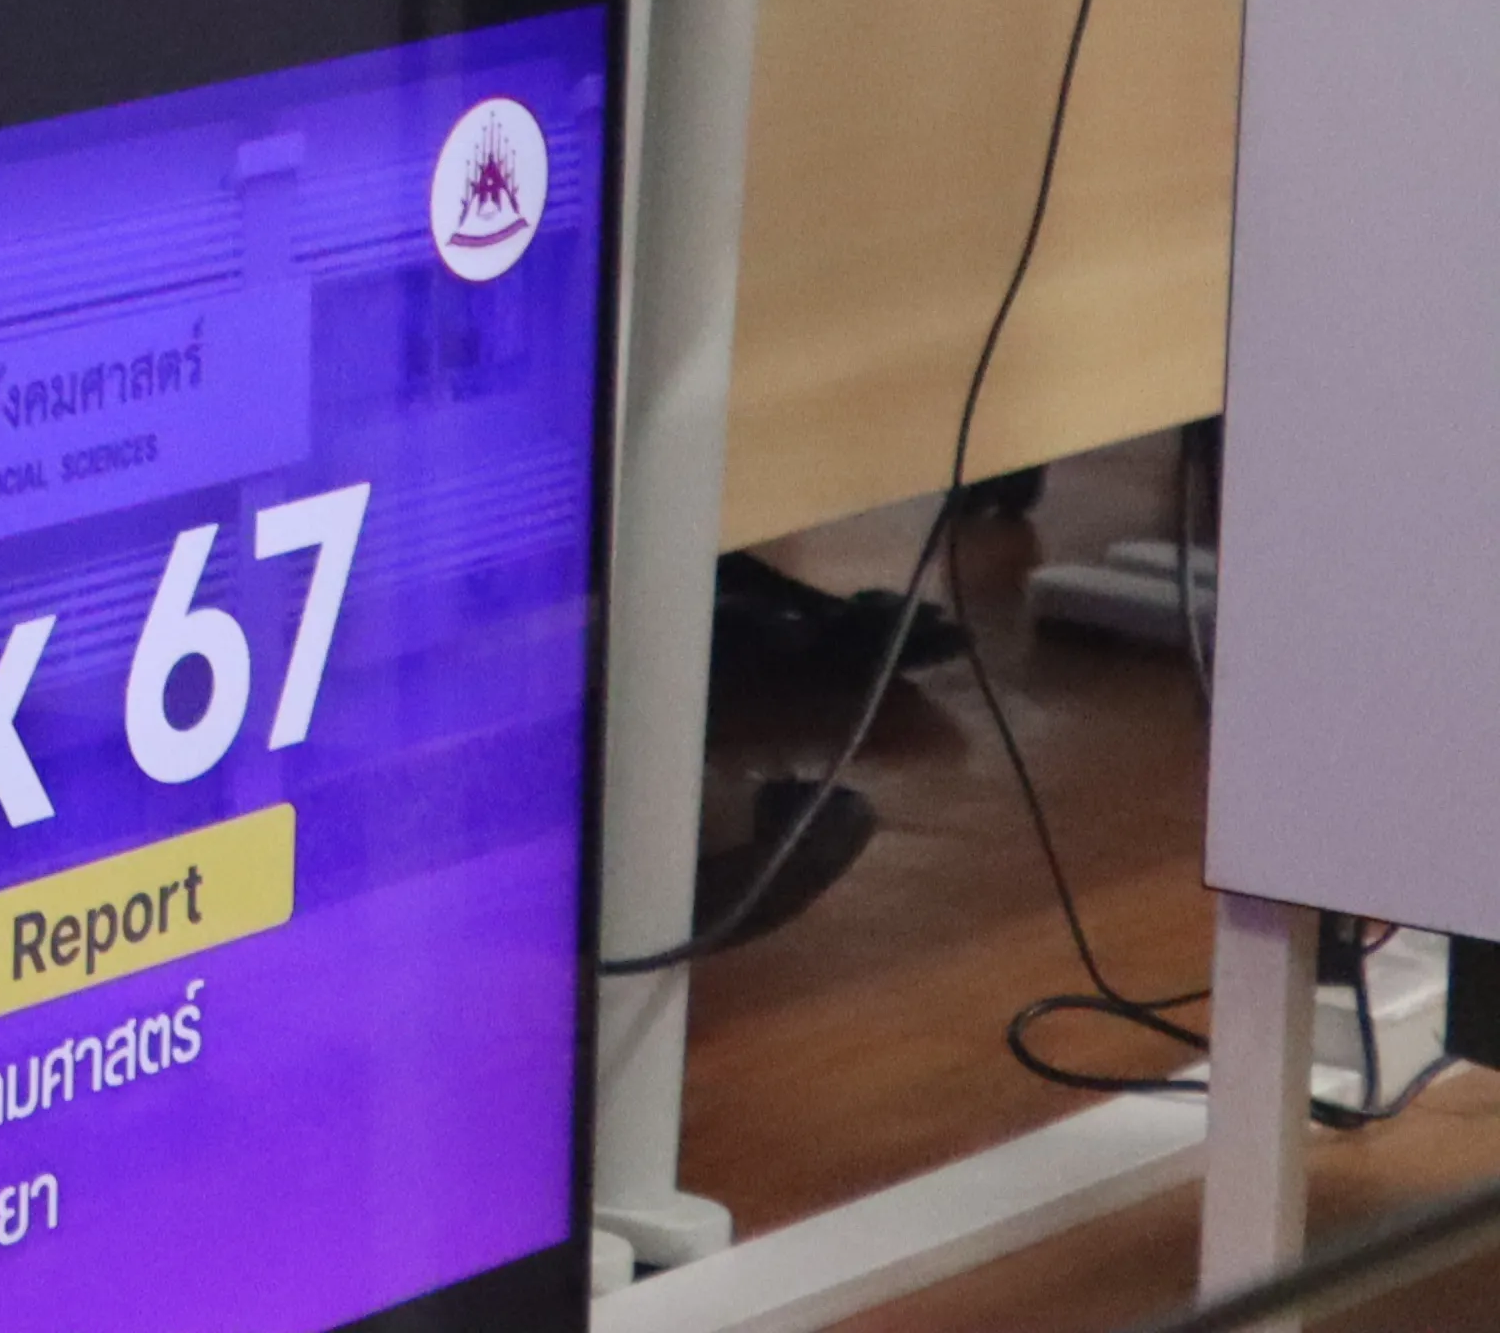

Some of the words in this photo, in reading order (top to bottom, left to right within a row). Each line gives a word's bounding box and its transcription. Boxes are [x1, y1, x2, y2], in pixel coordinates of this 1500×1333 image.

[59, 431, 161, 487] SCIENCES
[123, 481, 373, 787] 67
[9, 863, 206, 987] Report
